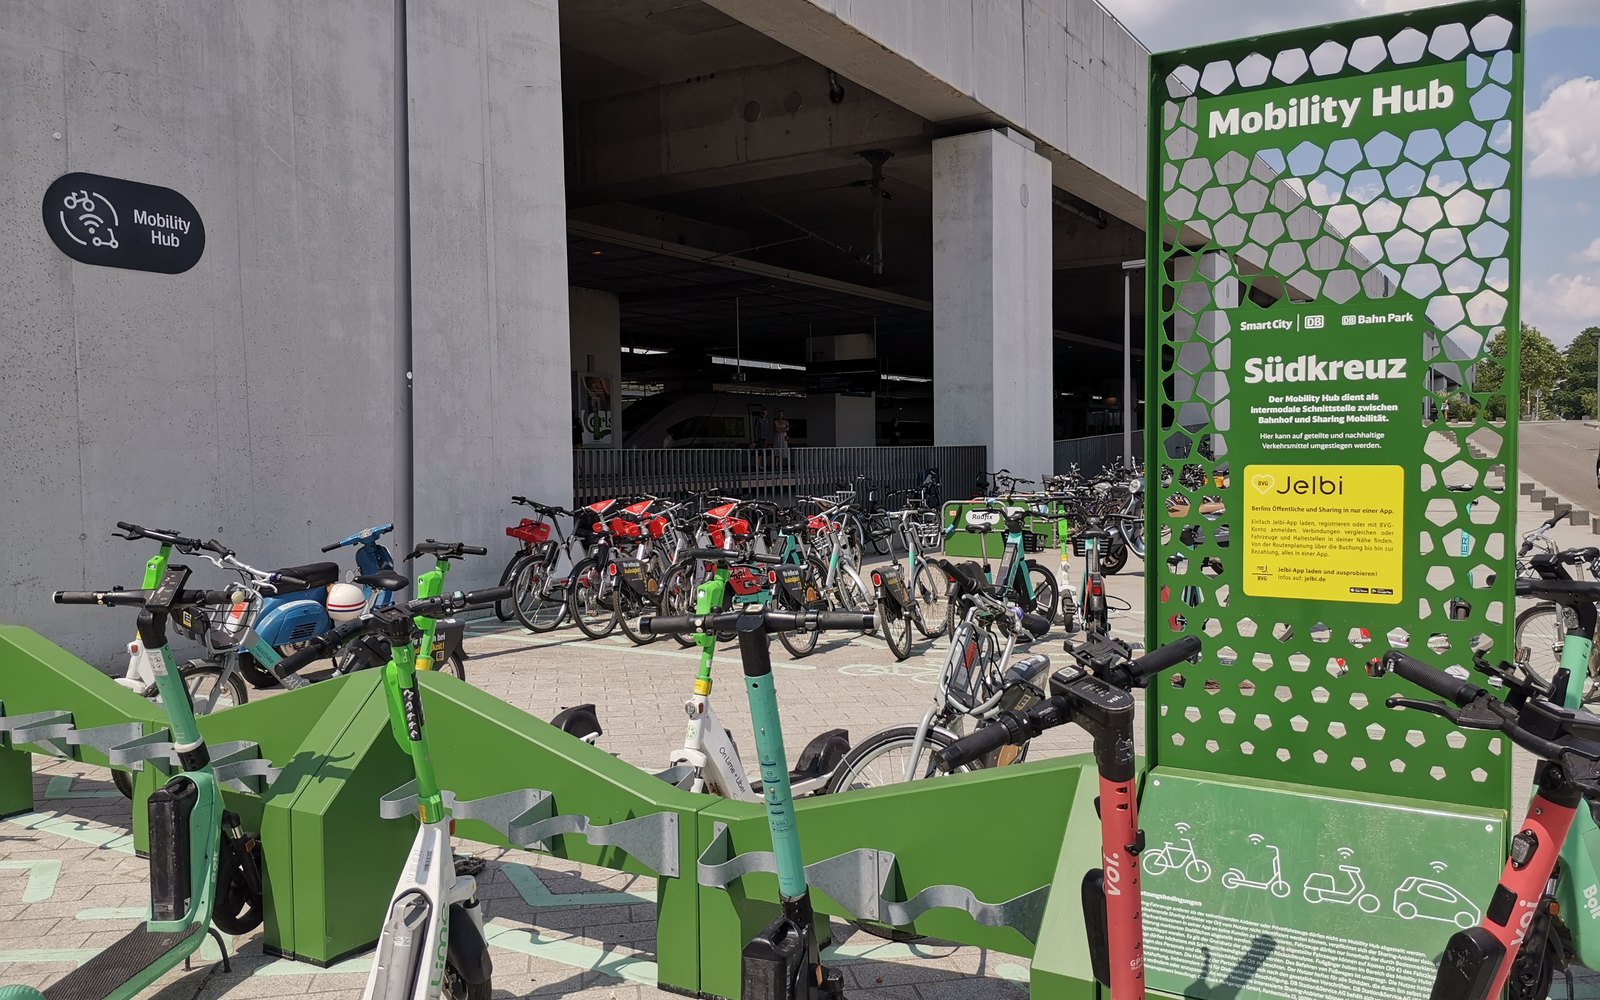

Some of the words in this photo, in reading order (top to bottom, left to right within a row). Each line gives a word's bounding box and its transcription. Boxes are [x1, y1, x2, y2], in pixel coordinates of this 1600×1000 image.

[1208, 93, 1361, 138] Mobility
[1372, 78, 1454, 117] Hub
[133, 209, 191, 234] Mobility
[151, 230, 180, 247] Hub
[1240, 320, 1271, 330] Smart
[1272, 319, 1292, 330] City
[1306, 316, 1323, 328] DB
[1358, 314, 1386, 324] Bahn
[1388, 312, 1414, 323] Park
[1244, 355, 1407, 384] Südkreuz
[1285, 394, 1320, 404] Mobility
[1251, 405, 1300, 414] intermodale
[1302, 404, 1356, 412] Schnittstelle
[1357, 403, 1398, 412] zwischen
[1312, 415, 1344, 424] Sharing
[1346, 414, 1389, 422] Mobilität.
[1277, 476, 1343, 495] Jelbi
[972, 514, 993, 522] Radfix
[718, 746, 728, 761] On
[724, 756, 736, 775] Lime
[735, 777, 746, 794] Uber
[1140, 890, 1202, 907] tzungsbedingungen
[431, 902, 450, 986] Lime
